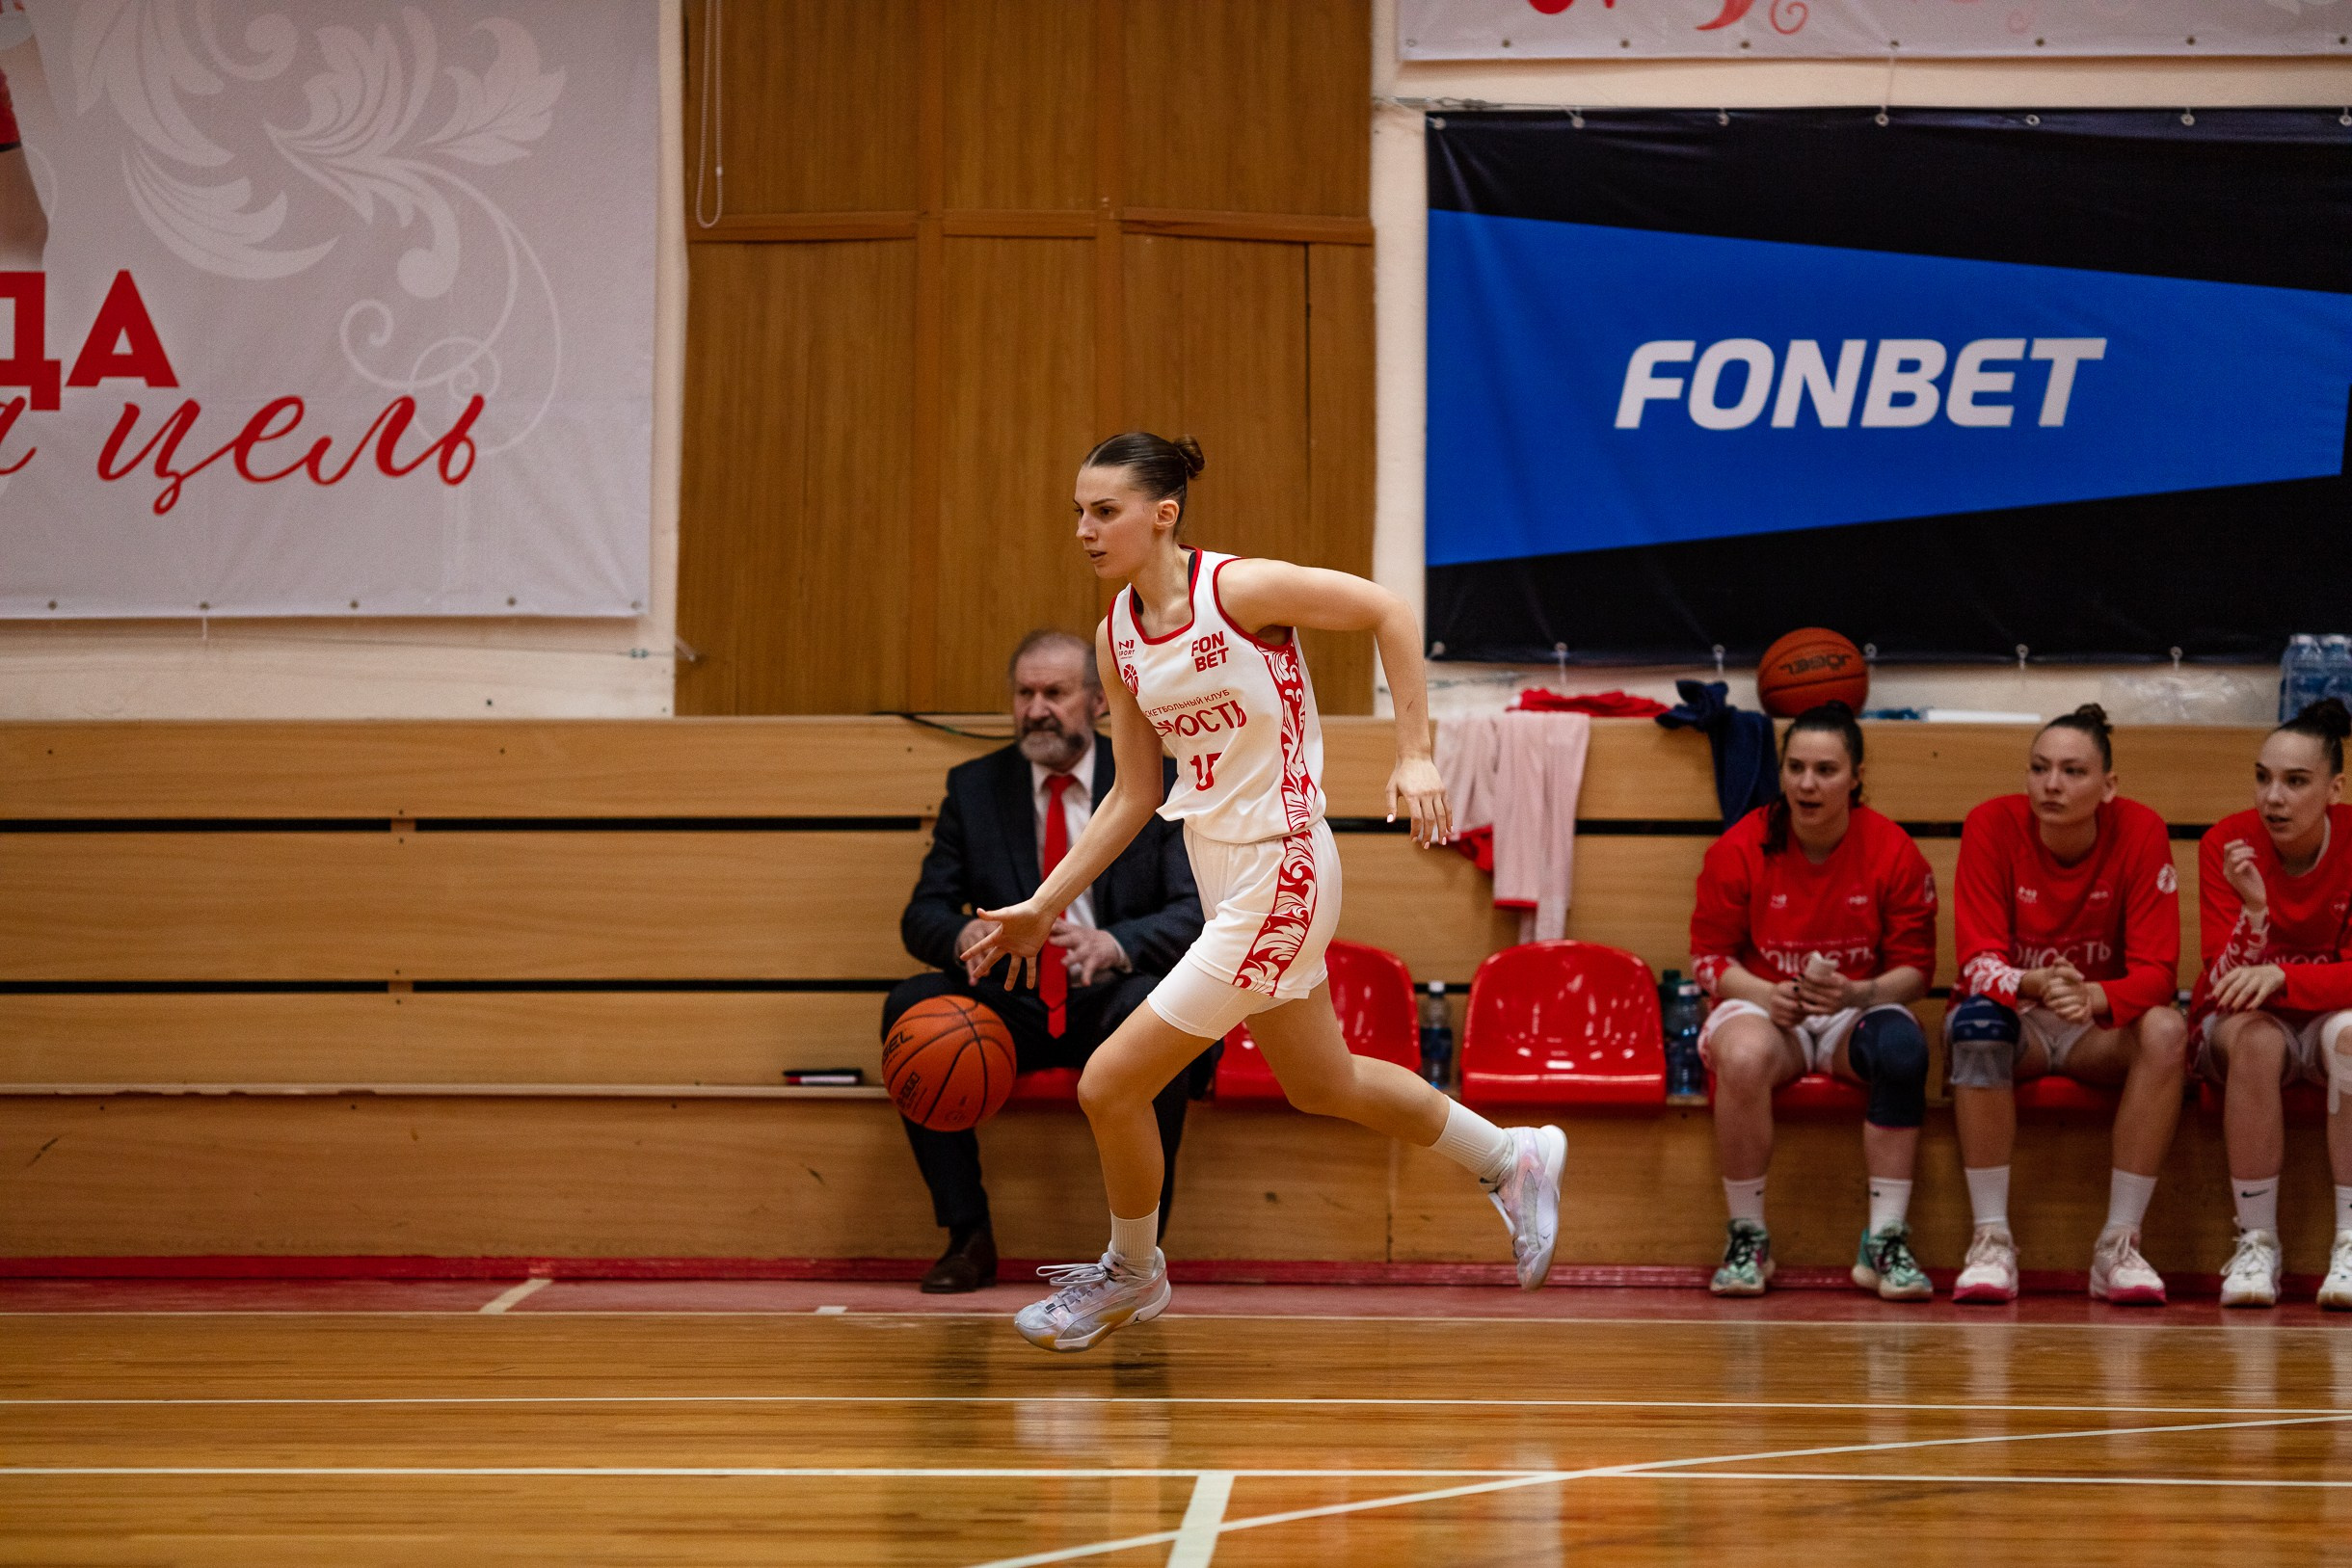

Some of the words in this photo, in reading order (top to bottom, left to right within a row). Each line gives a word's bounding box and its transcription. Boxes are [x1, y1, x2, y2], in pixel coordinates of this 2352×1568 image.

[1614, 337, 2108, 431] FONBET
[97, 393, 485, 516] цель
[1190, 630, 1225, 657] FON
[1194, 647, 1229, 673] BET
[1204, 689, 1230, 703] КЛУБ
